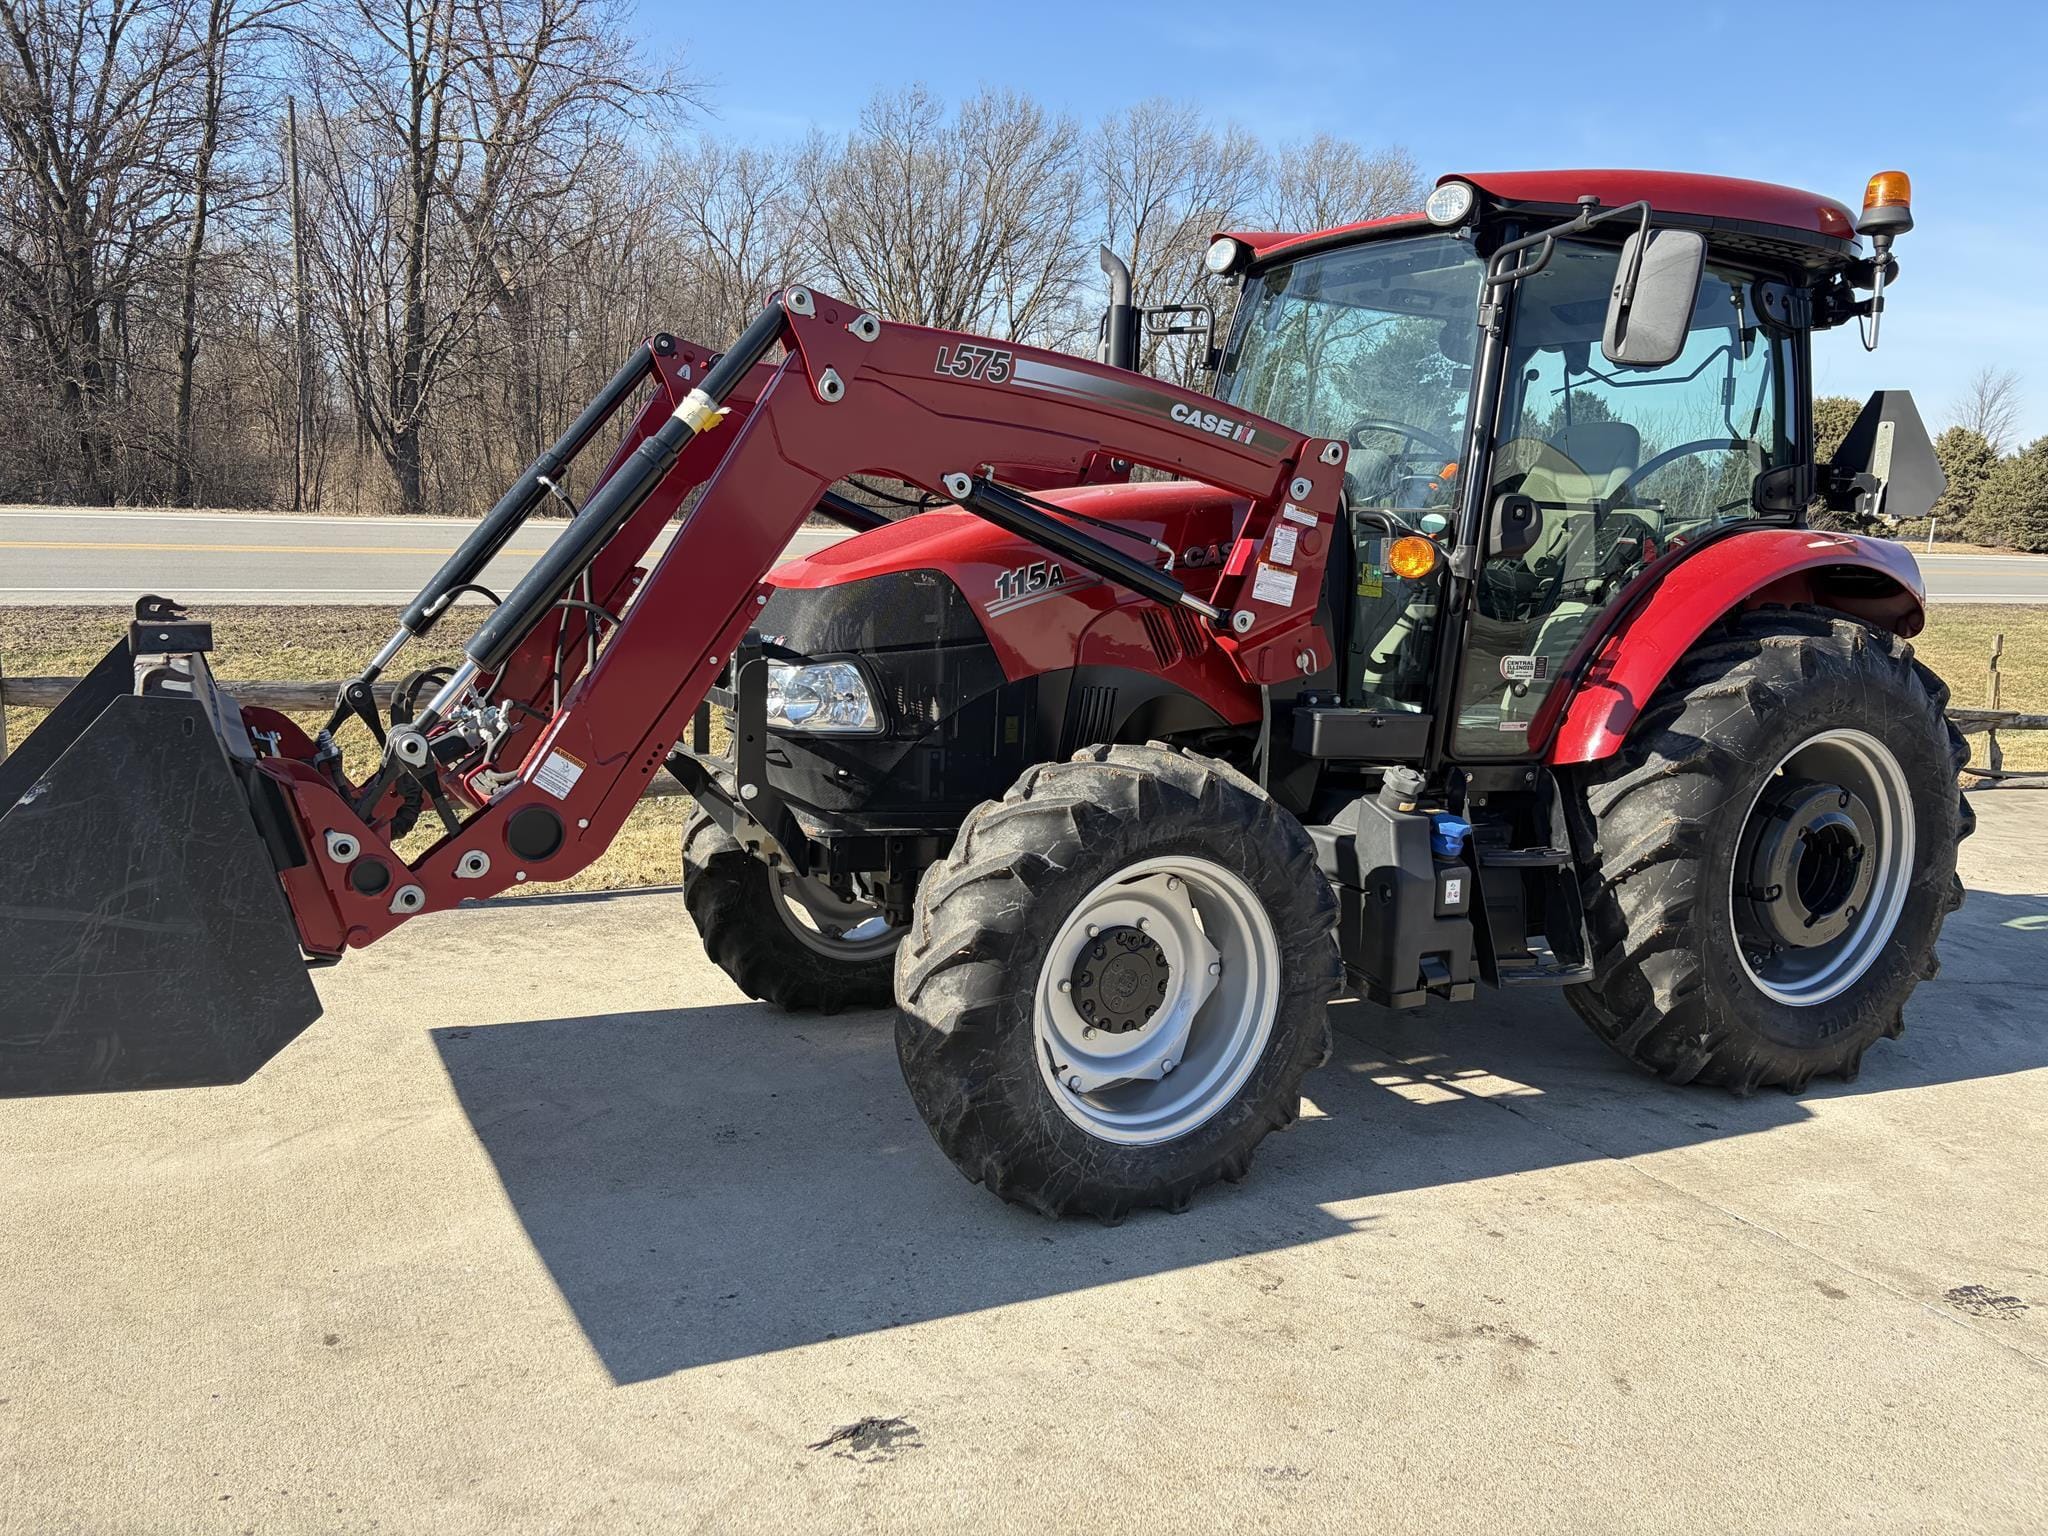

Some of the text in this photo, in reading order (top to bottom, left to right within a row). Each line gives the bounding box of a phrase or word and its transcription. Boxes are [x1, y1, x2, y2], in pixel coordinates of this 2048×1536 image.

[934, 343, 1012, 384] L575
[1170, 403, 1235, 438] CASE
[995, 560, 1066, 601] 115A
